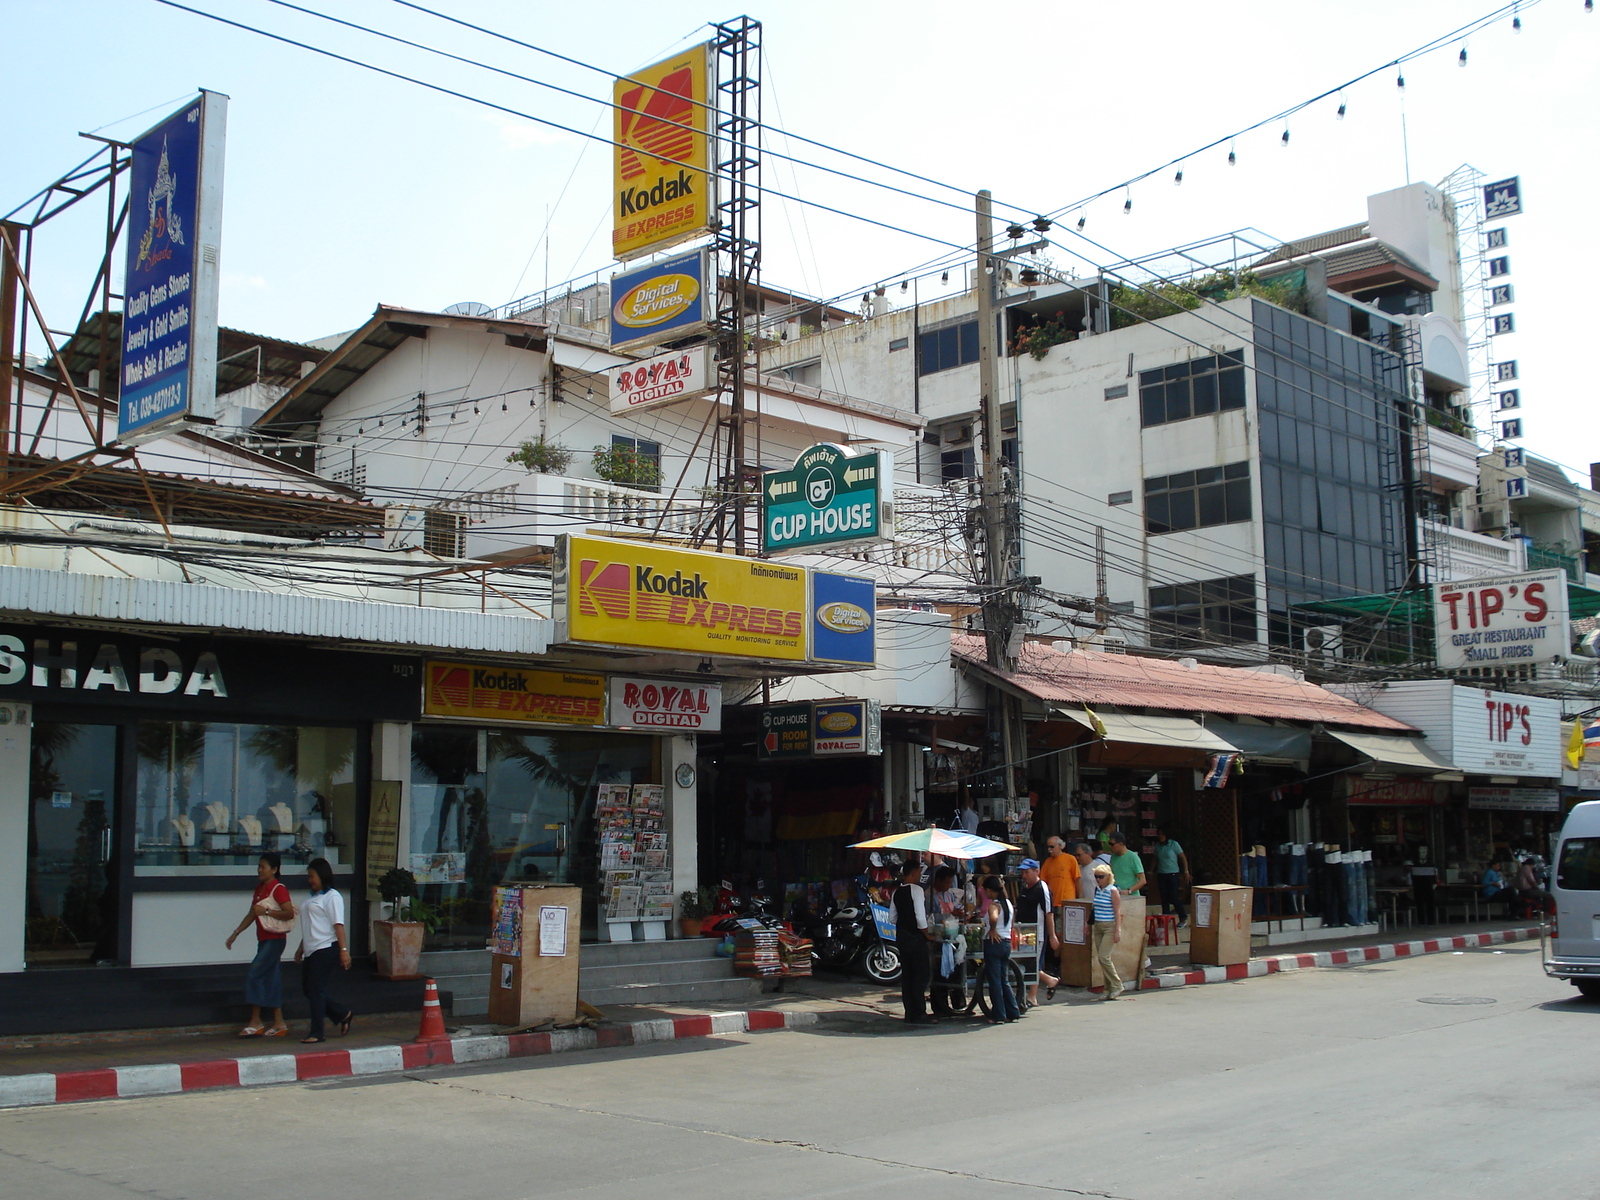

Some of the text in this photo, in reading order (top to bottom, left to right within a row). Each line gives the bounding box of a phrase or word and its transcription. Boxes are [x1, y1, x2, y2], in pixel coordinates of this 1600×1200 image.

[621, 170, 693, 217] Kodak
[627, 203, 694, 238] EXPRESS
[145, 240, 172, 272] Shada
[635, 279, 679, 303] Digital
[1489, 230, 1509, 332] MIKE
[128, 272, 190, 319] Quality Gems Stones
[632, 292, 684, 318] Services
[126, 304, 189, 353] Jewelry & Gold Smiths
[125, 340, 188, 386] Whole Sale & Retailer
[620, 354, 692, 393] ROYAL
[630, 381, 683, 404] DIGITAL
[128, 400, 139, 424] Tel.
[1500, 363, 1520, 496] HOTEL
[770, 502, 872, 541] CUP HOUSE
[636, 564, 708, 599] Kodak
[1440, 584, 1453, 592] THE
[668, 597, 802, 637] EXPRESS
[833, 606, 861, 618] Digital
[1441, 583, 1548, 630] TIP'S
[830, 614, 865, 628] Services
[707, 632, 798, 647] QUALITY MONITORING SERVICE
[1452, 626, 1547, 647] GREAT RESTAURANT
[0, 634, 228, 698] SHADA
[1467, 645, 1534, 662] SMALL PRICES
[473, 669, 528, 692] Kodak
[499, 692, 601, 717] EXPRESS
[624, 683, 710, 713] ROYAL
[635, 712, 699, 726] DIGITAL
[772, 714, 807, 726] CUP HOUSE
[1485, 701, 1531, 746] TIP'S
[782, 731, 808, 741] ROOM
[782, 741, 808, 750] FOR RENT
[816, 742, 844, 750] ROYAL
